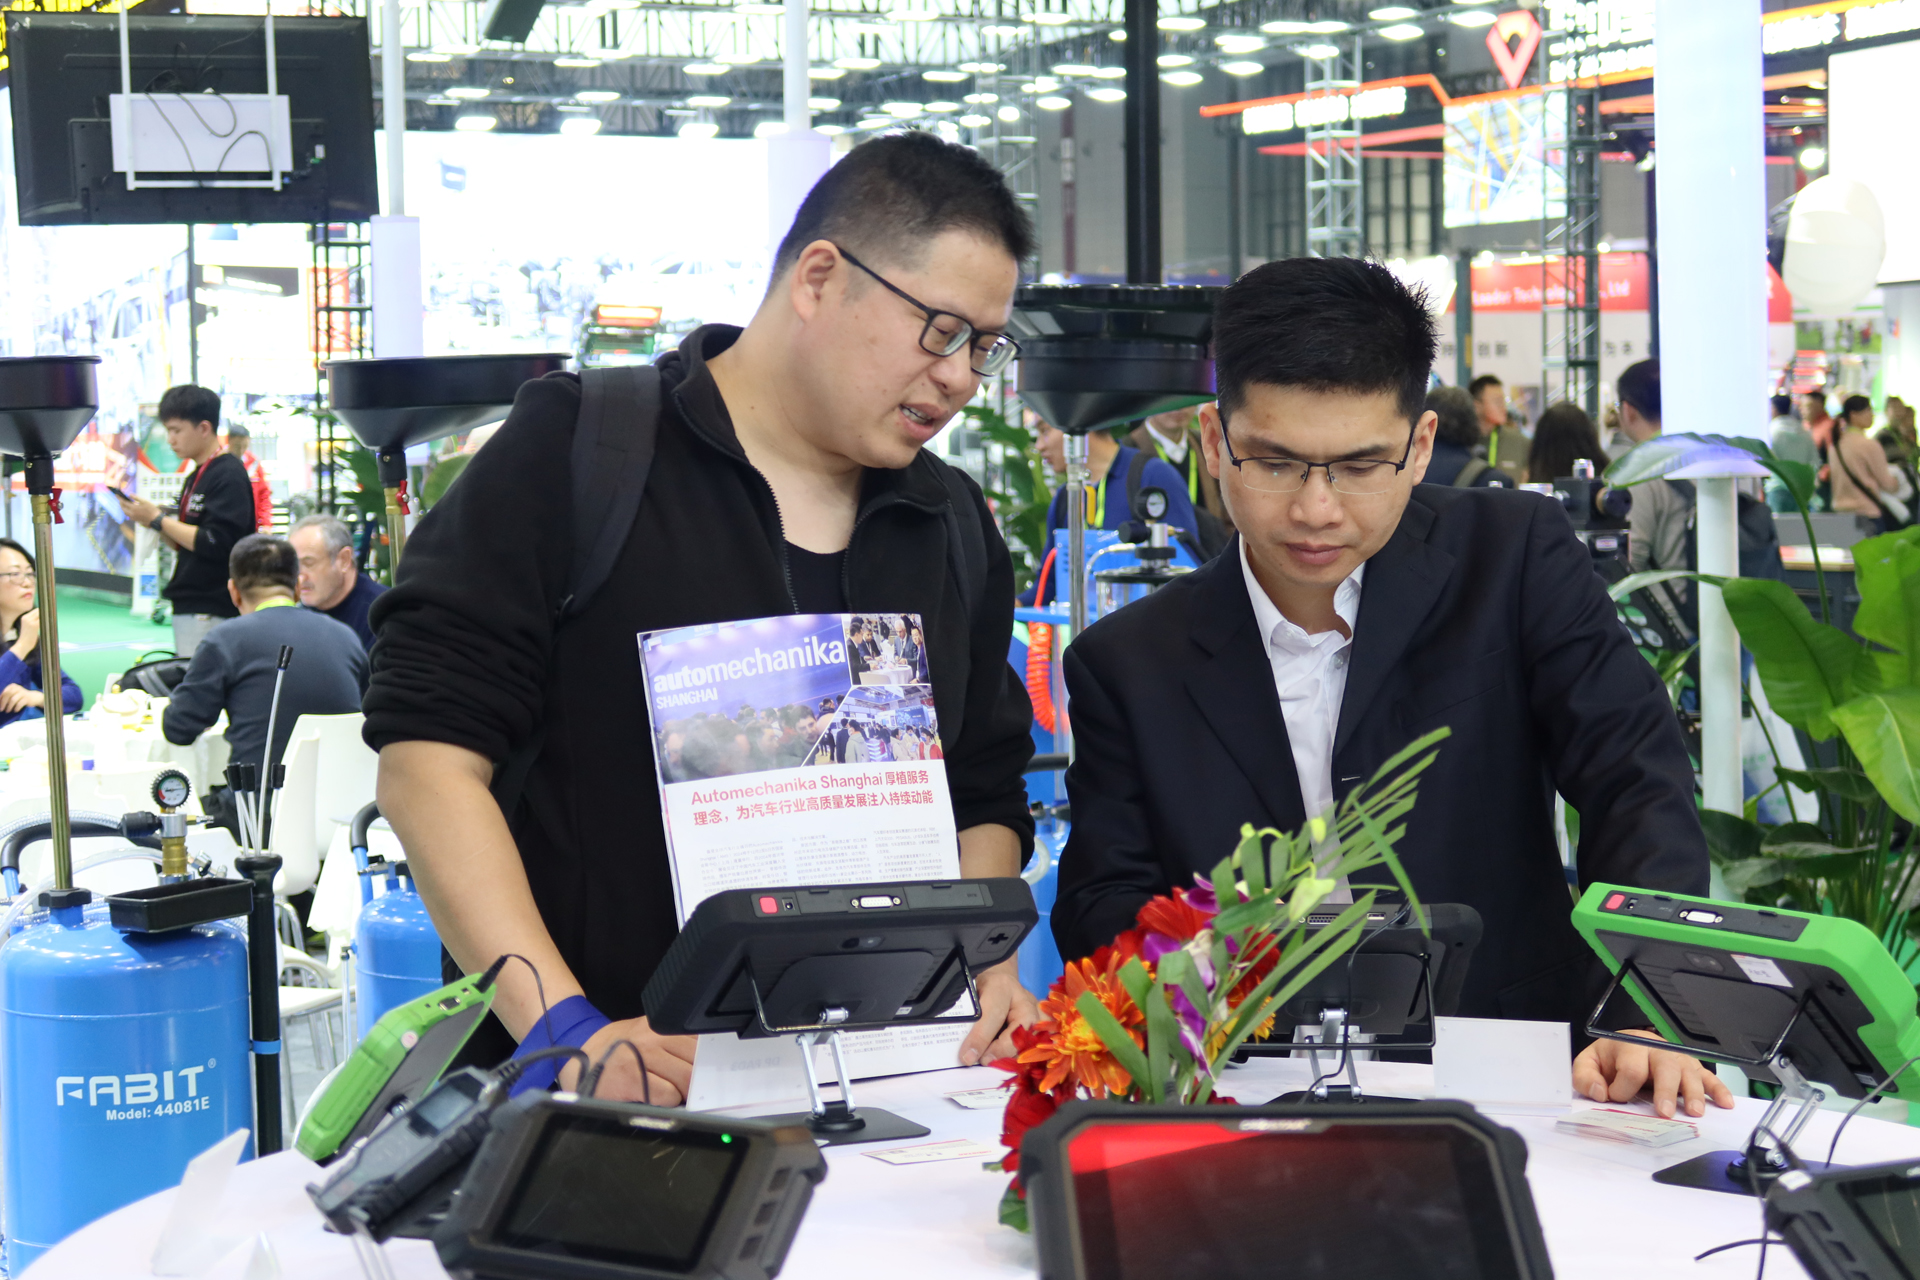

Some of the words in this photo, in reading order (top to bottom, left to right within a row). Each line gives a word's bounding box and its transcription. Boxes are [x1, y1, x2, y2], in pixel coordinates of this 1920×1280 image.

[653, 636, 846, 693] automechanika
[656, 687, 718, 710] SHANGHAI
[691, 777, 817, 806] Automechanika
[820, 772, 883, 791] Shanghai
[885, 769, 929, 786] 厚植服务
[106, 1107, 151, 1121] Model:
[154, 1096, 210, 1117] 44081E
